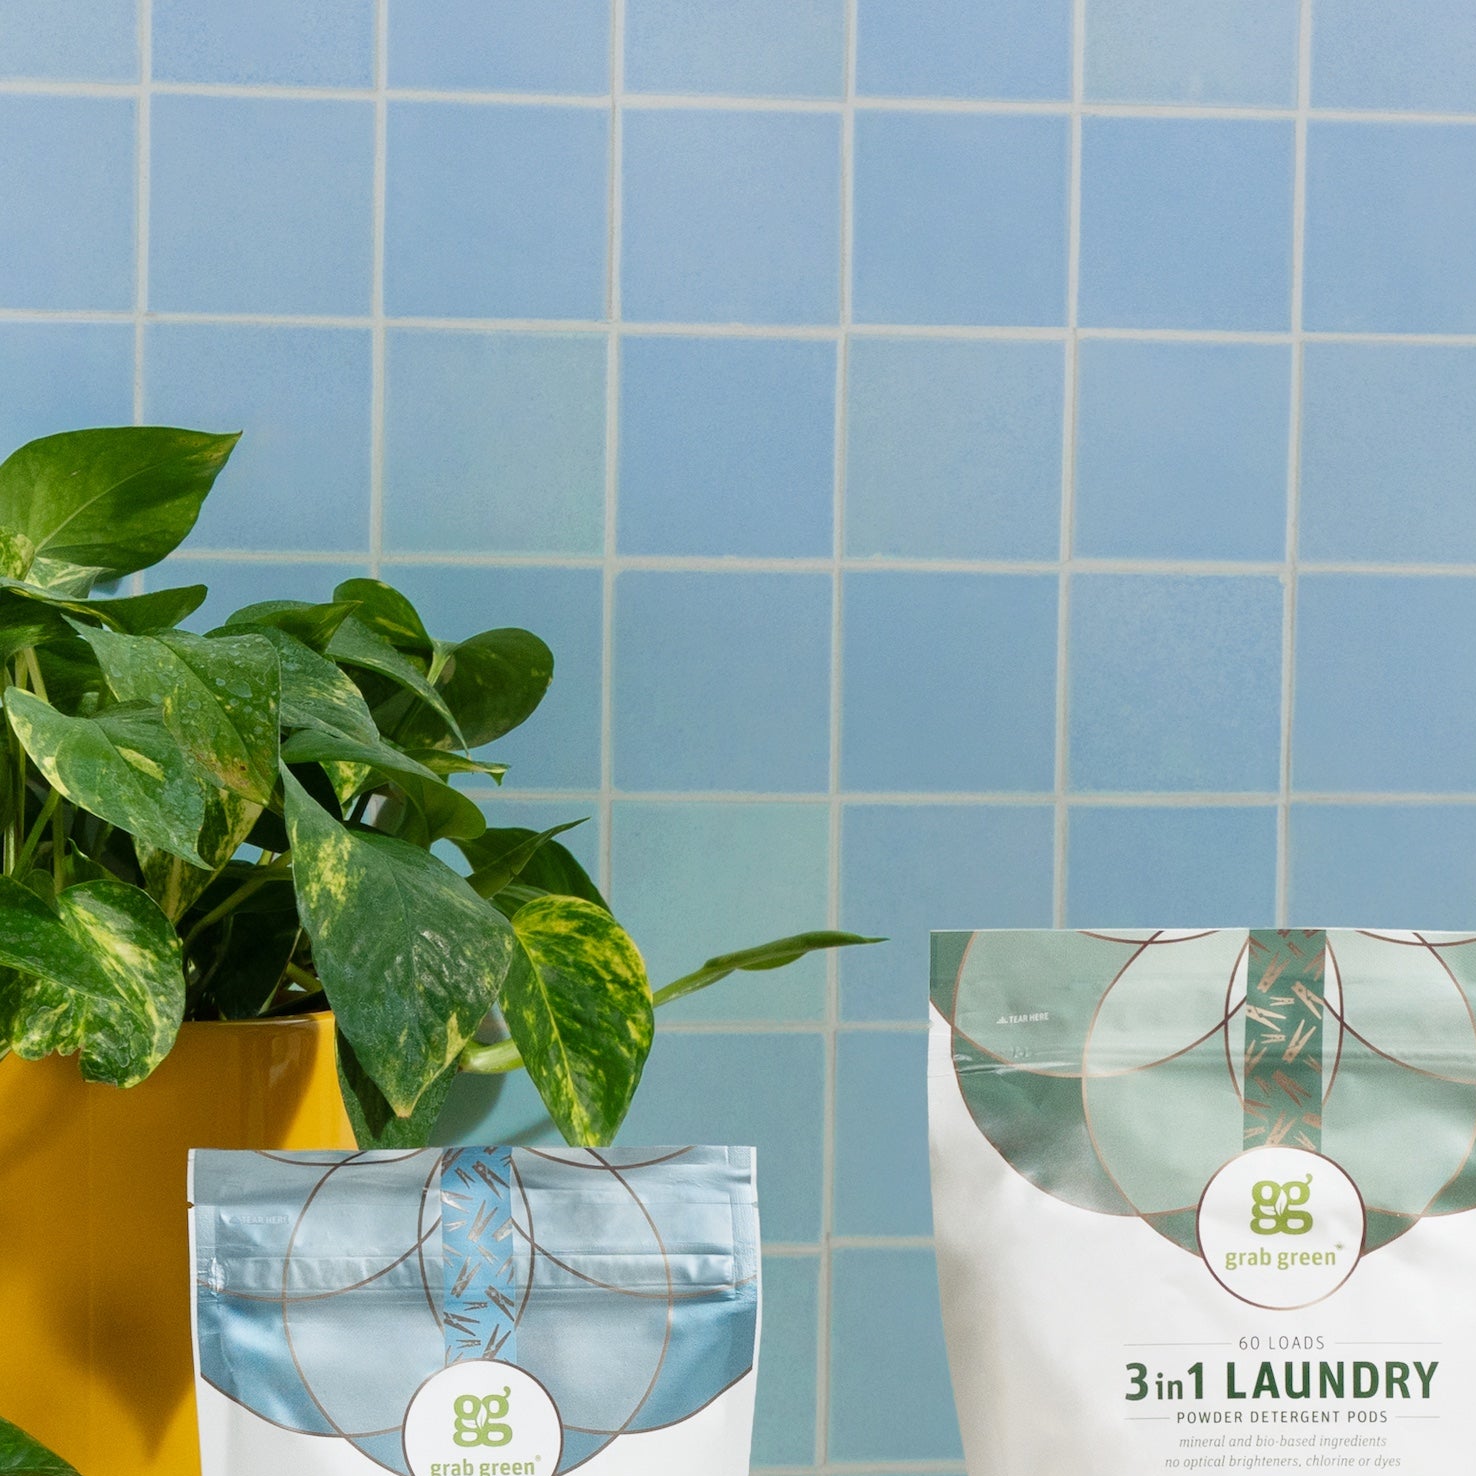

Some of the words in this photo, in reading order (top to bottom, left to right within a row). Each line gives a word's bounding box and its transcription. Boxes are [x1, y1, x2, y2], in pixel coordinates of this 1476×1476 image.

[1009, 1015, 1028, 1023] TEAR
[1029, 1012, 1049, 1021] HERE
[1225, 1246, 1271, 1270] grab
[1239, 1336, 1259, 1350] 60
[1269, 1336, 1324, 1350] LOADS
[1226, 1360, 1441, 1401] LAUNDRY
[1177, 1411, 1242, 1424] POWDER
[1251, 1411, 1339, 1423] DETERGENT
[1348, 1411, 1387, 1423] PODS
[1179, 1435, 1225, 1448] mineral
[1229, 1435, 1252, 1447] and
[1256, 1435, 1316, 1447] bio-based
[1320, 1435, 1386, 1449] ingredients
[1165, 1459, 1180, 1467] no
[1183, 1455, 1225, 1470] optical
[1229, 1455, 1301, 1470] brighteners,
[1306, 1455, 1355, 1466] chlorine
[1358, 1458, 1371, 1466] or
[1374, 1454, 1400, 1469] dyes
